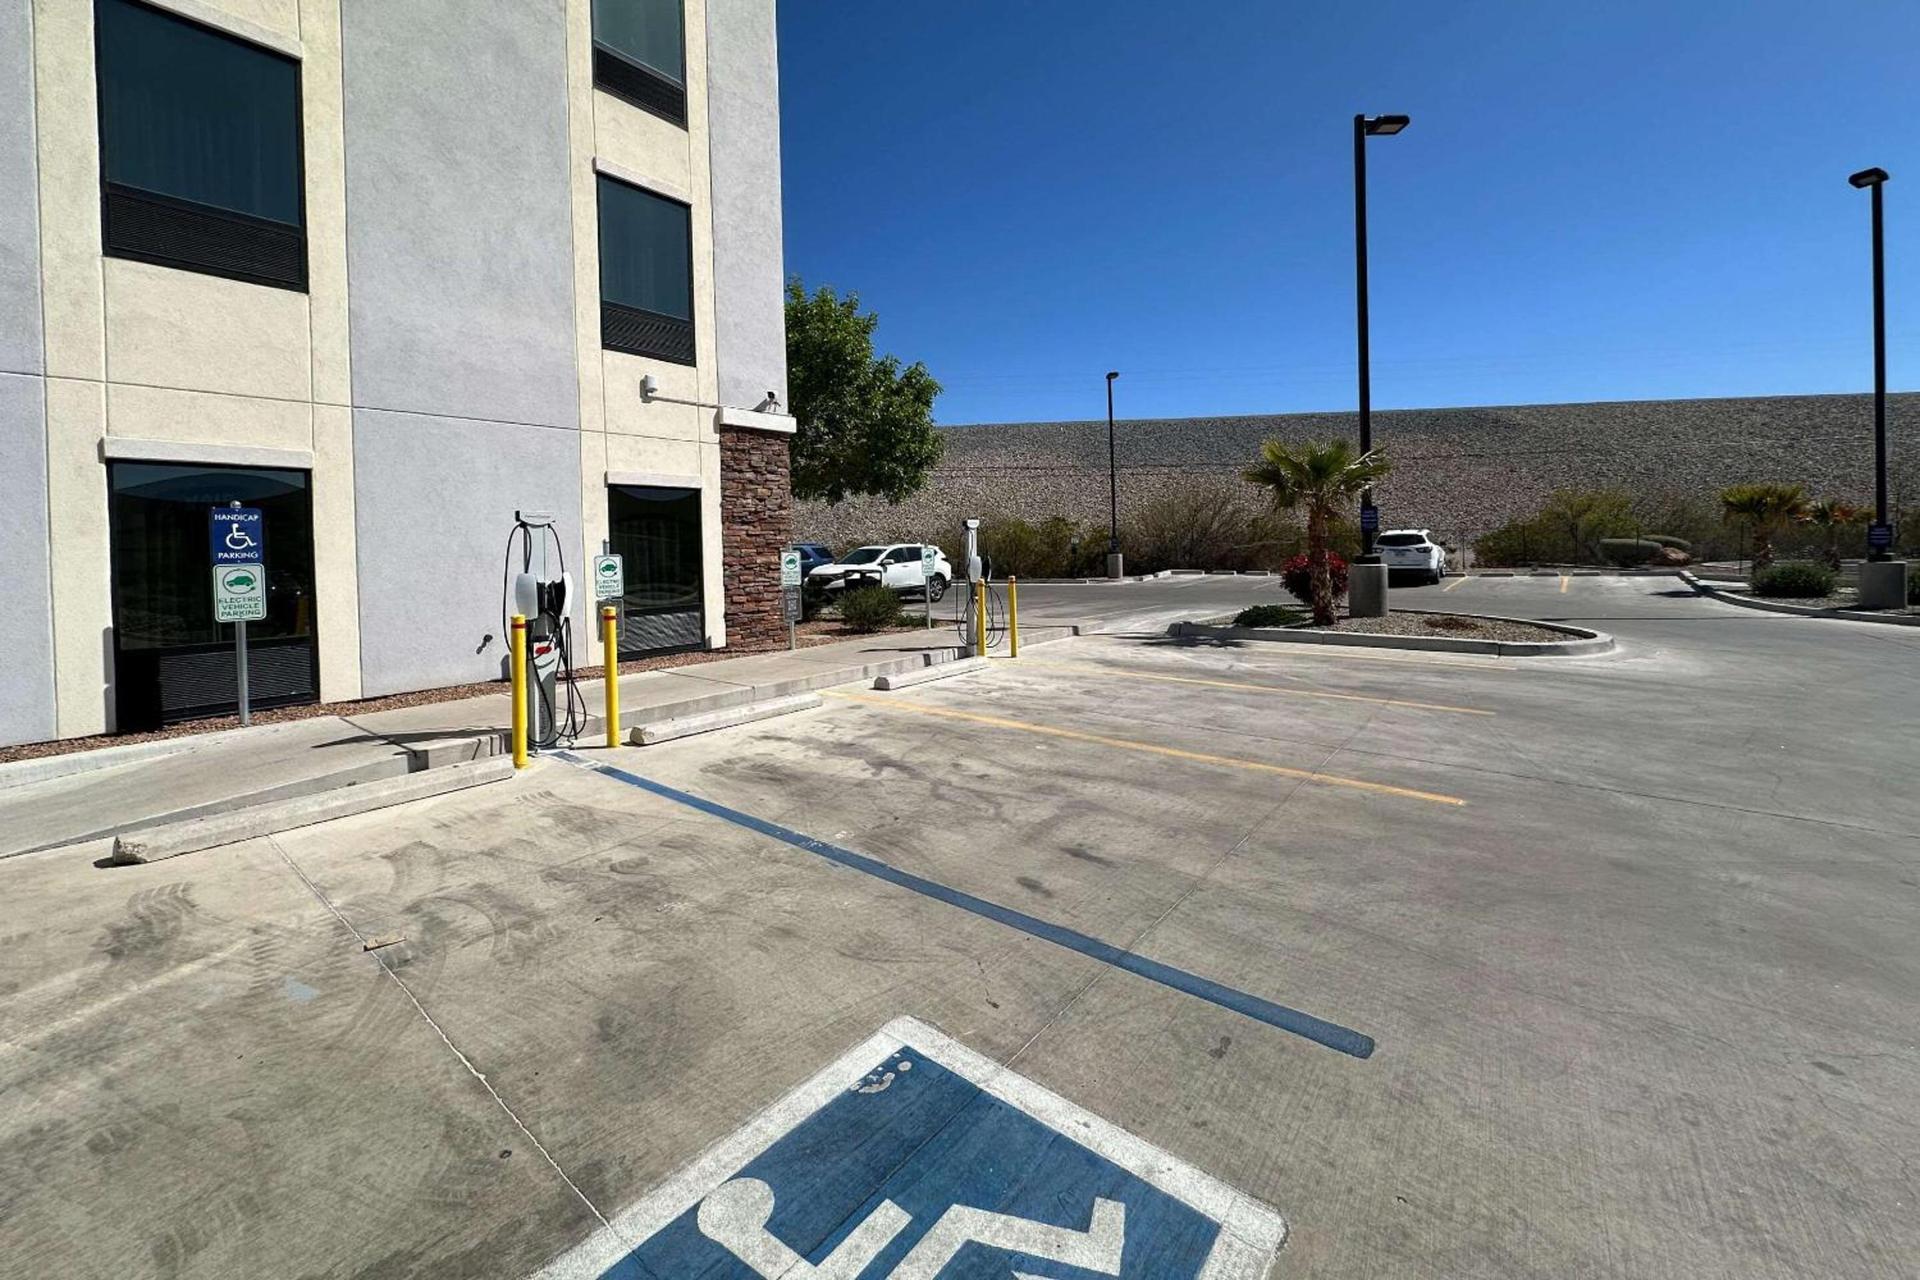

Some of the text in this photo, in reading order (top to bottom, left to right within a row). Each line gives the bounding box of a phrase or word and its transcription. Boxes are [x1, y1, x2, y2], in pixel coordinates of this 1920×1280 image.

[214, 513, 259, 522] HANDICAP
[219, 596, 261, 604] ELECTRIC
[221, 603, 260, 611] VEHICLE
[221, 610, 260, 618] PARKING
